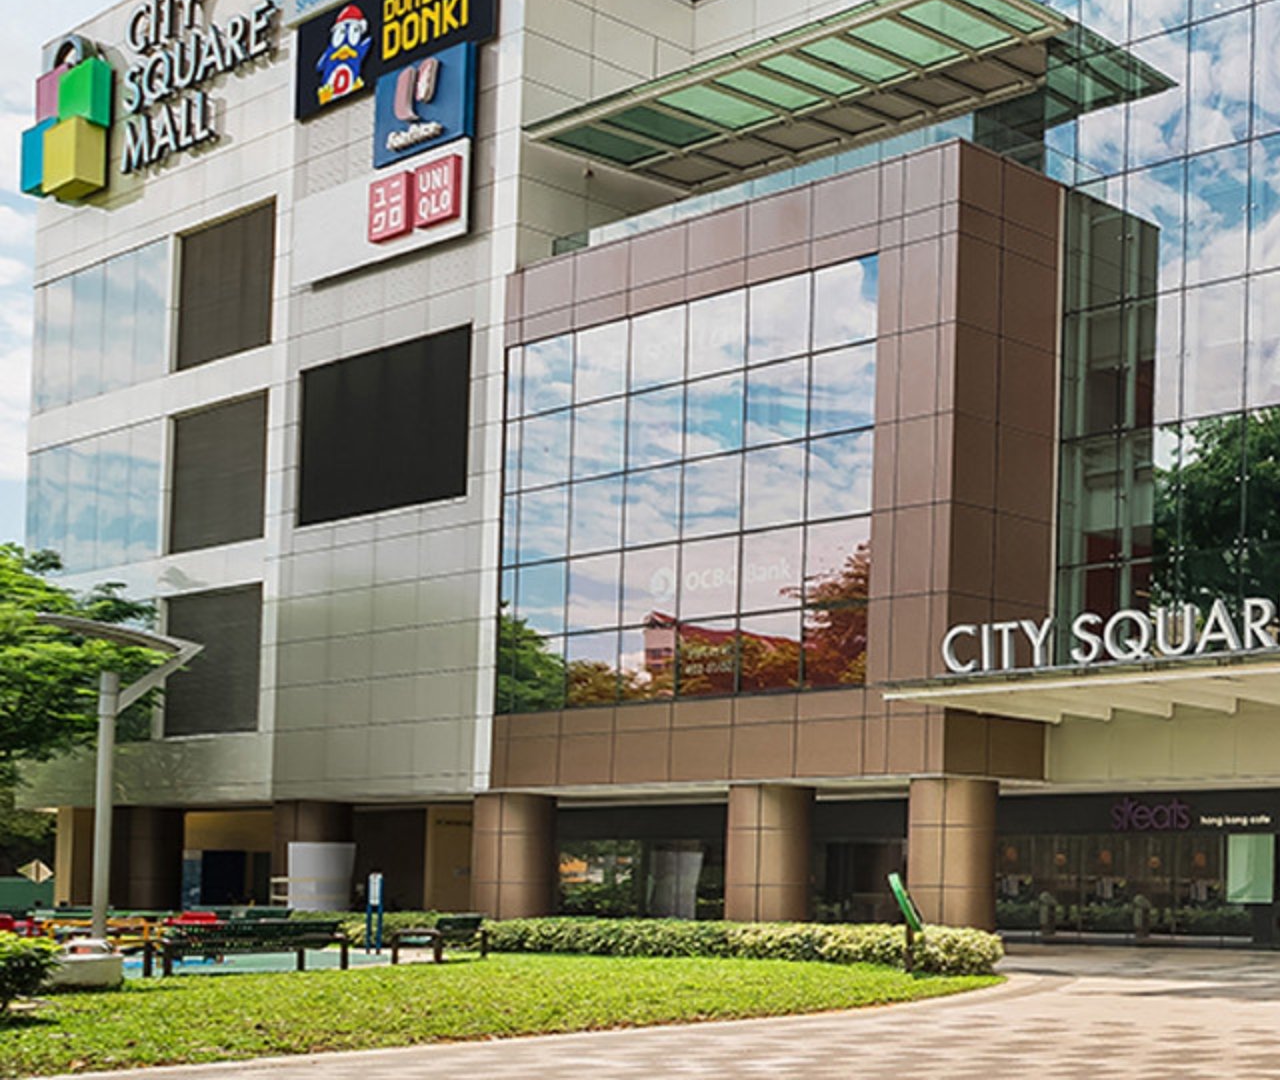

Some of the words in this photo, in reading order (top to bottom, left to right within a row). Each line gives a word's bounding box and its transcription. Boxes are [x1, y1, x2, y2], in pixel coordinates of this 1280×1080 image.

[120, 90, 216, 174] MALL
[373, 179, 401, 209] ユニ
[419, 165, 449, 193] UNI
[418, 189, 451, 219] QLO
[372, 206, 401, 233] クロ
[941, 617, 1054, 674] CITY
[1111, 795, 1190, 831] streats
